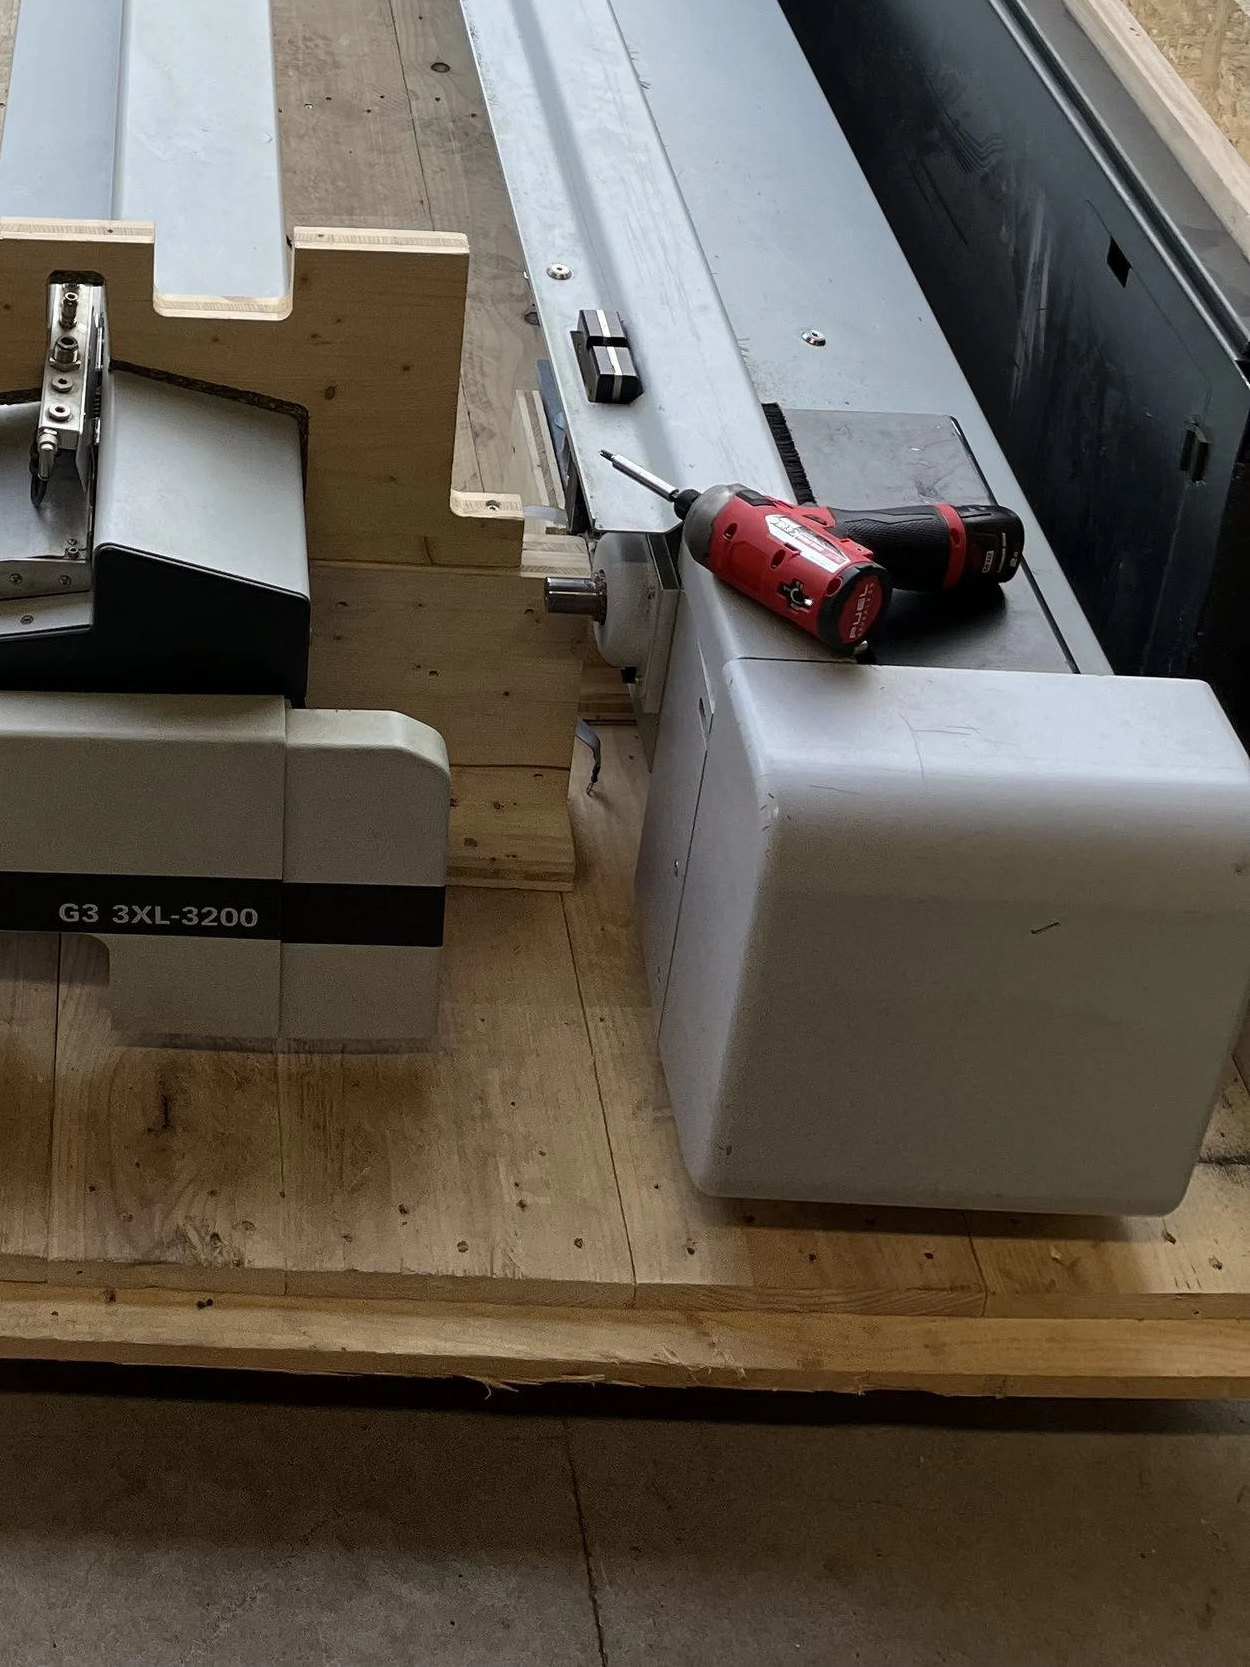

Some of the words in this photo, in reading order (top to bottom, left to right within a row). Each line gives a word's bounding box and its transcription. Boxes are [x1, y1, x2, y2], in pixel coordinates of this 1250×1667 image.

[849, 584, 869, 639] FUEL
[58, 903, 99, 923] G3
[112, 904, 259, 928] 3XL-3200
